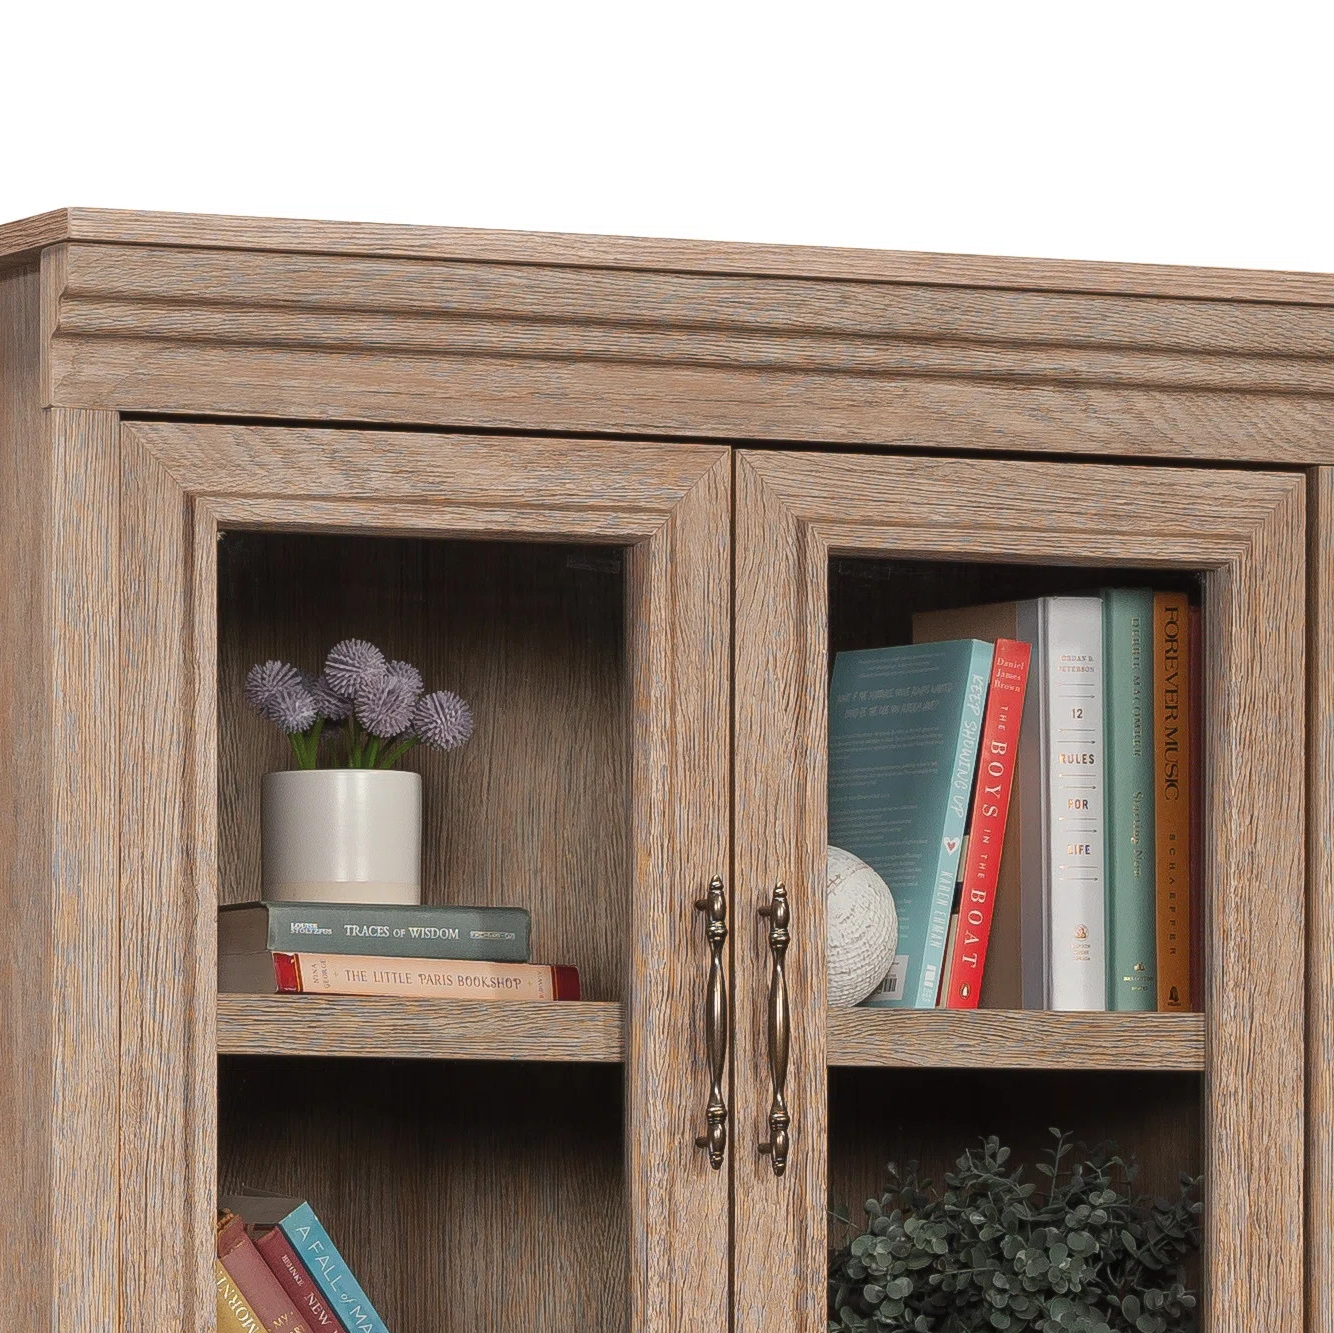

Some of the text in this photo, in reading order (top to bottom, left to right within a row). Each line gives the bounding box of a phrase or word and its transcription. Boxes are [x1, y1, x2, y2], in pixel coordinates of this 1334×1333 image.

[996, 657, 1025, 671] Daniel
[995, 668, 1021, 681] James
[994, 679, 1021, 693] Brown
[1164, 606, 1180, 801] FOREVER MUSIC
[1071, 708, 1083, 719] 12
[1058, 753, 1095, 765] RULES
[1068, 799, 1089, 810] FOR
[961, 705, 1009, 969] THE BOYS IN THE BOAT
[1067, 844, 1091, 855] LIFE
[343, 924, 390, 938] TRACES
[392, 928, 406, 938] OF
[407, 926, 460, 940] WISDOM
[344, 969, 522, 990] THE LITTLE PARIS BOOKSHOP
[295, 1224, 312, 1242] A
[307, 1240, 341, 1293] FALL
[340, 1293, 356, 1305] of
[303, 1291, 335, 1327] NEW
